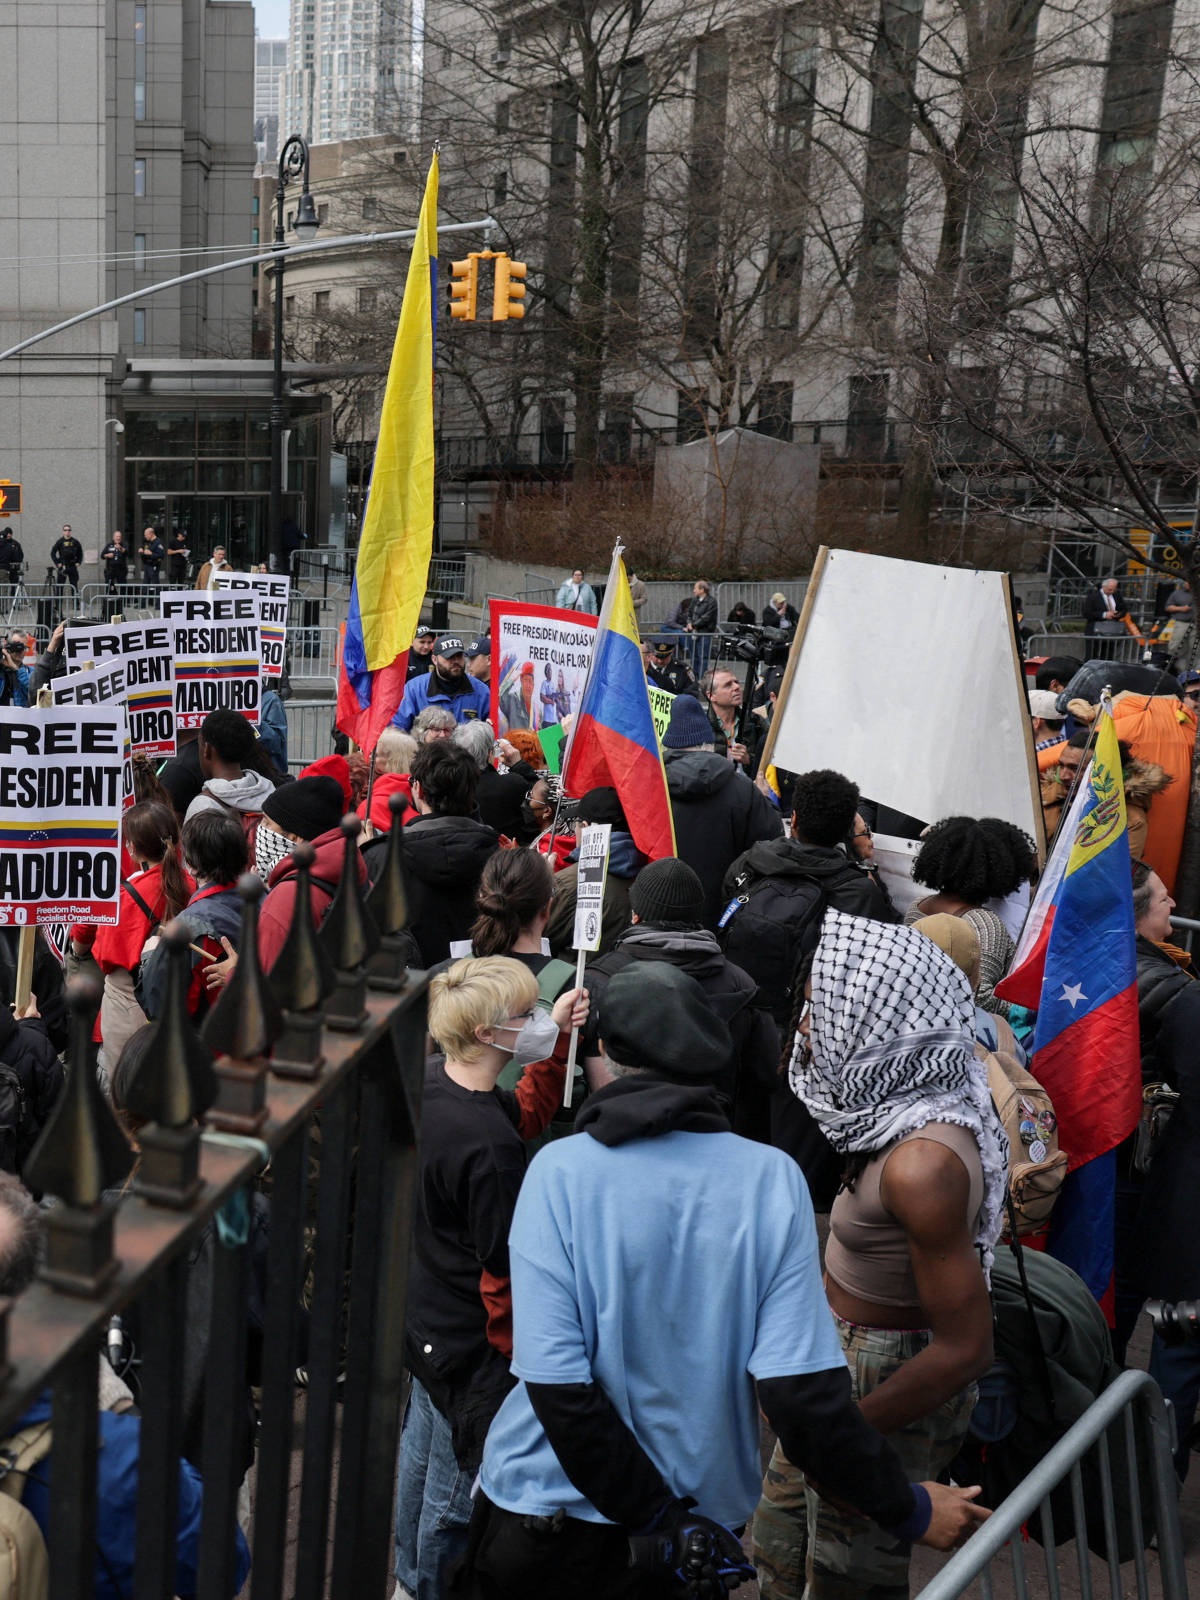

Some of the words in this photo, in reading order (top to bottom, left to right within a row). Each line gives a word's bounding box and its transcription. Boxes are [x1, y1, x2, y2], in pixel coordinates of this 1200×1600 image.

[163, 599, 255, 621] FREE
[503, 622, 521, 635] FREE
[67, 628, 170, 658] FREE
[174, 626, 259, 655] RESIDENT
[441, 639, 462, 650] NYPD
[529, 645, 549, 661] FREE
[54, 669, 125, 706] FREE
[36, 906, 69, 914] Freedom
[70, 905, 91, 914] Road
[36, 914, 67, 923] Socialist
[67, 913, 116, 924] Organization
